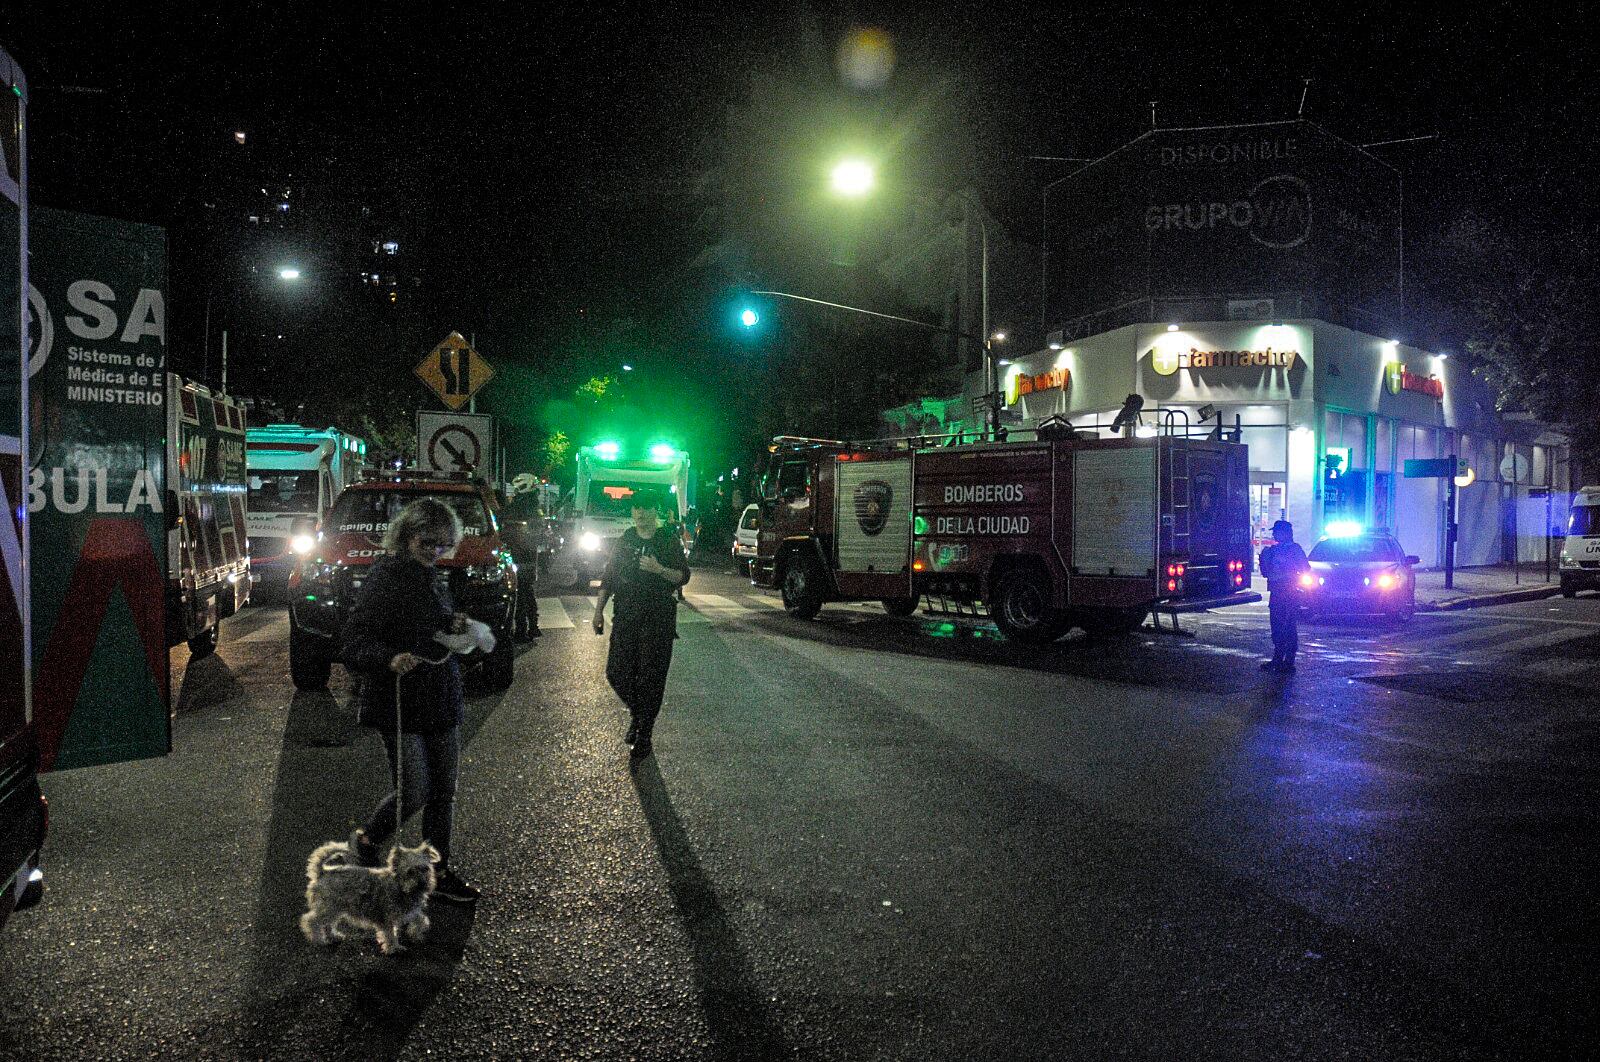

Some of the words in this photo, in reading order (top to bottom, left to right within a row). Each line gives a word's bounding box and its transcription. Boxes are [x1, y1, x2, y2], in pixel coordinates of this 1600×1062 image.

[1160, 138, 1298, 166] DISPONIBLE
[1144, 200, 1253, 231] GRUPO
[67, 346, 132, 366] Sistema
[136, 353, 155, 368] de
[1180, 346, 1296, 371] farmacity
[67, 365, 125, 384] Médica
[129, 371, 148, 386] de
[152, 373, 163, 387] E
[67, 386, 163, 406] MINISTERIO
[943, 484, 1024, 503] BOMBEROS
[339, 522, 373, 532] GRUPO
[937, 516, 954, 535] DE
[957, 516, 976, 534] LA
[977, 515, 1030, 535] CIUDAD
